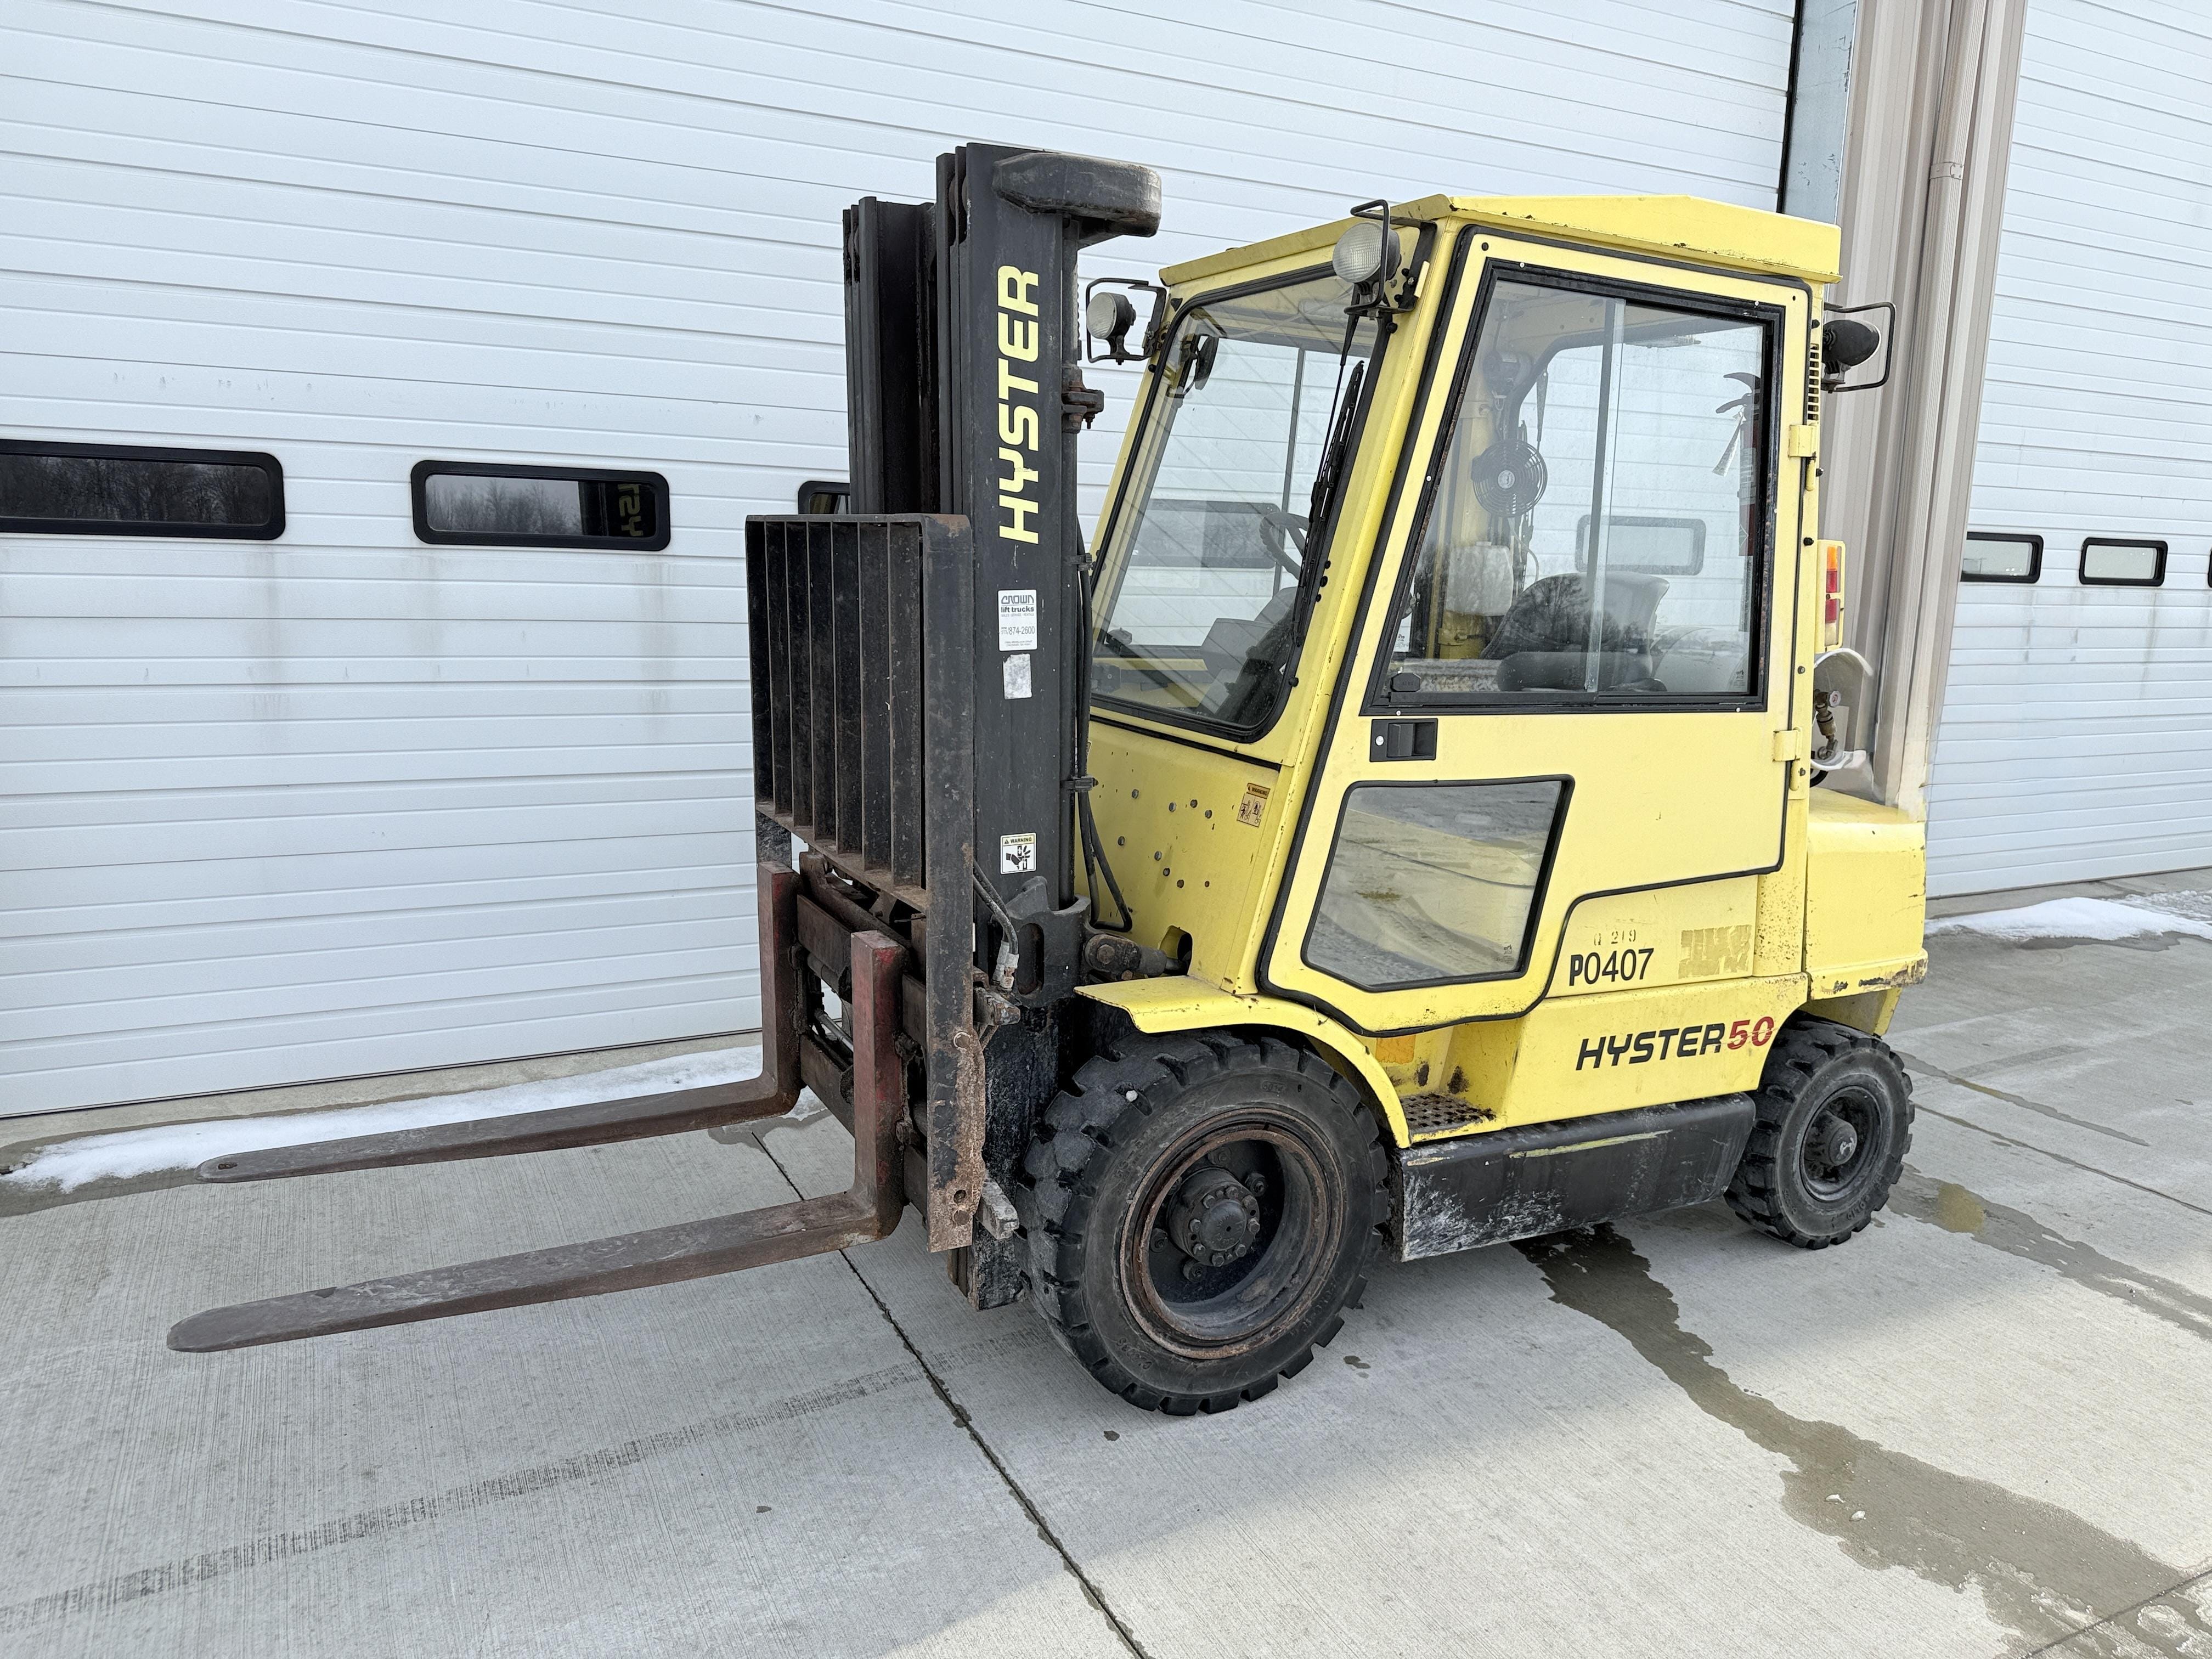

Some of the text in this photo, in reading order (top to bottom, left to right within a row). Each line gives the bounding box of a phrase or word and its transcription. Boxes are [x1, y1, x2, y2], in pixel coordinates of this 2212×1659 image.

[997, 265, 1039, 544] HYSTER
[1576, 1016, 1775, 1071] HYSTER 50
